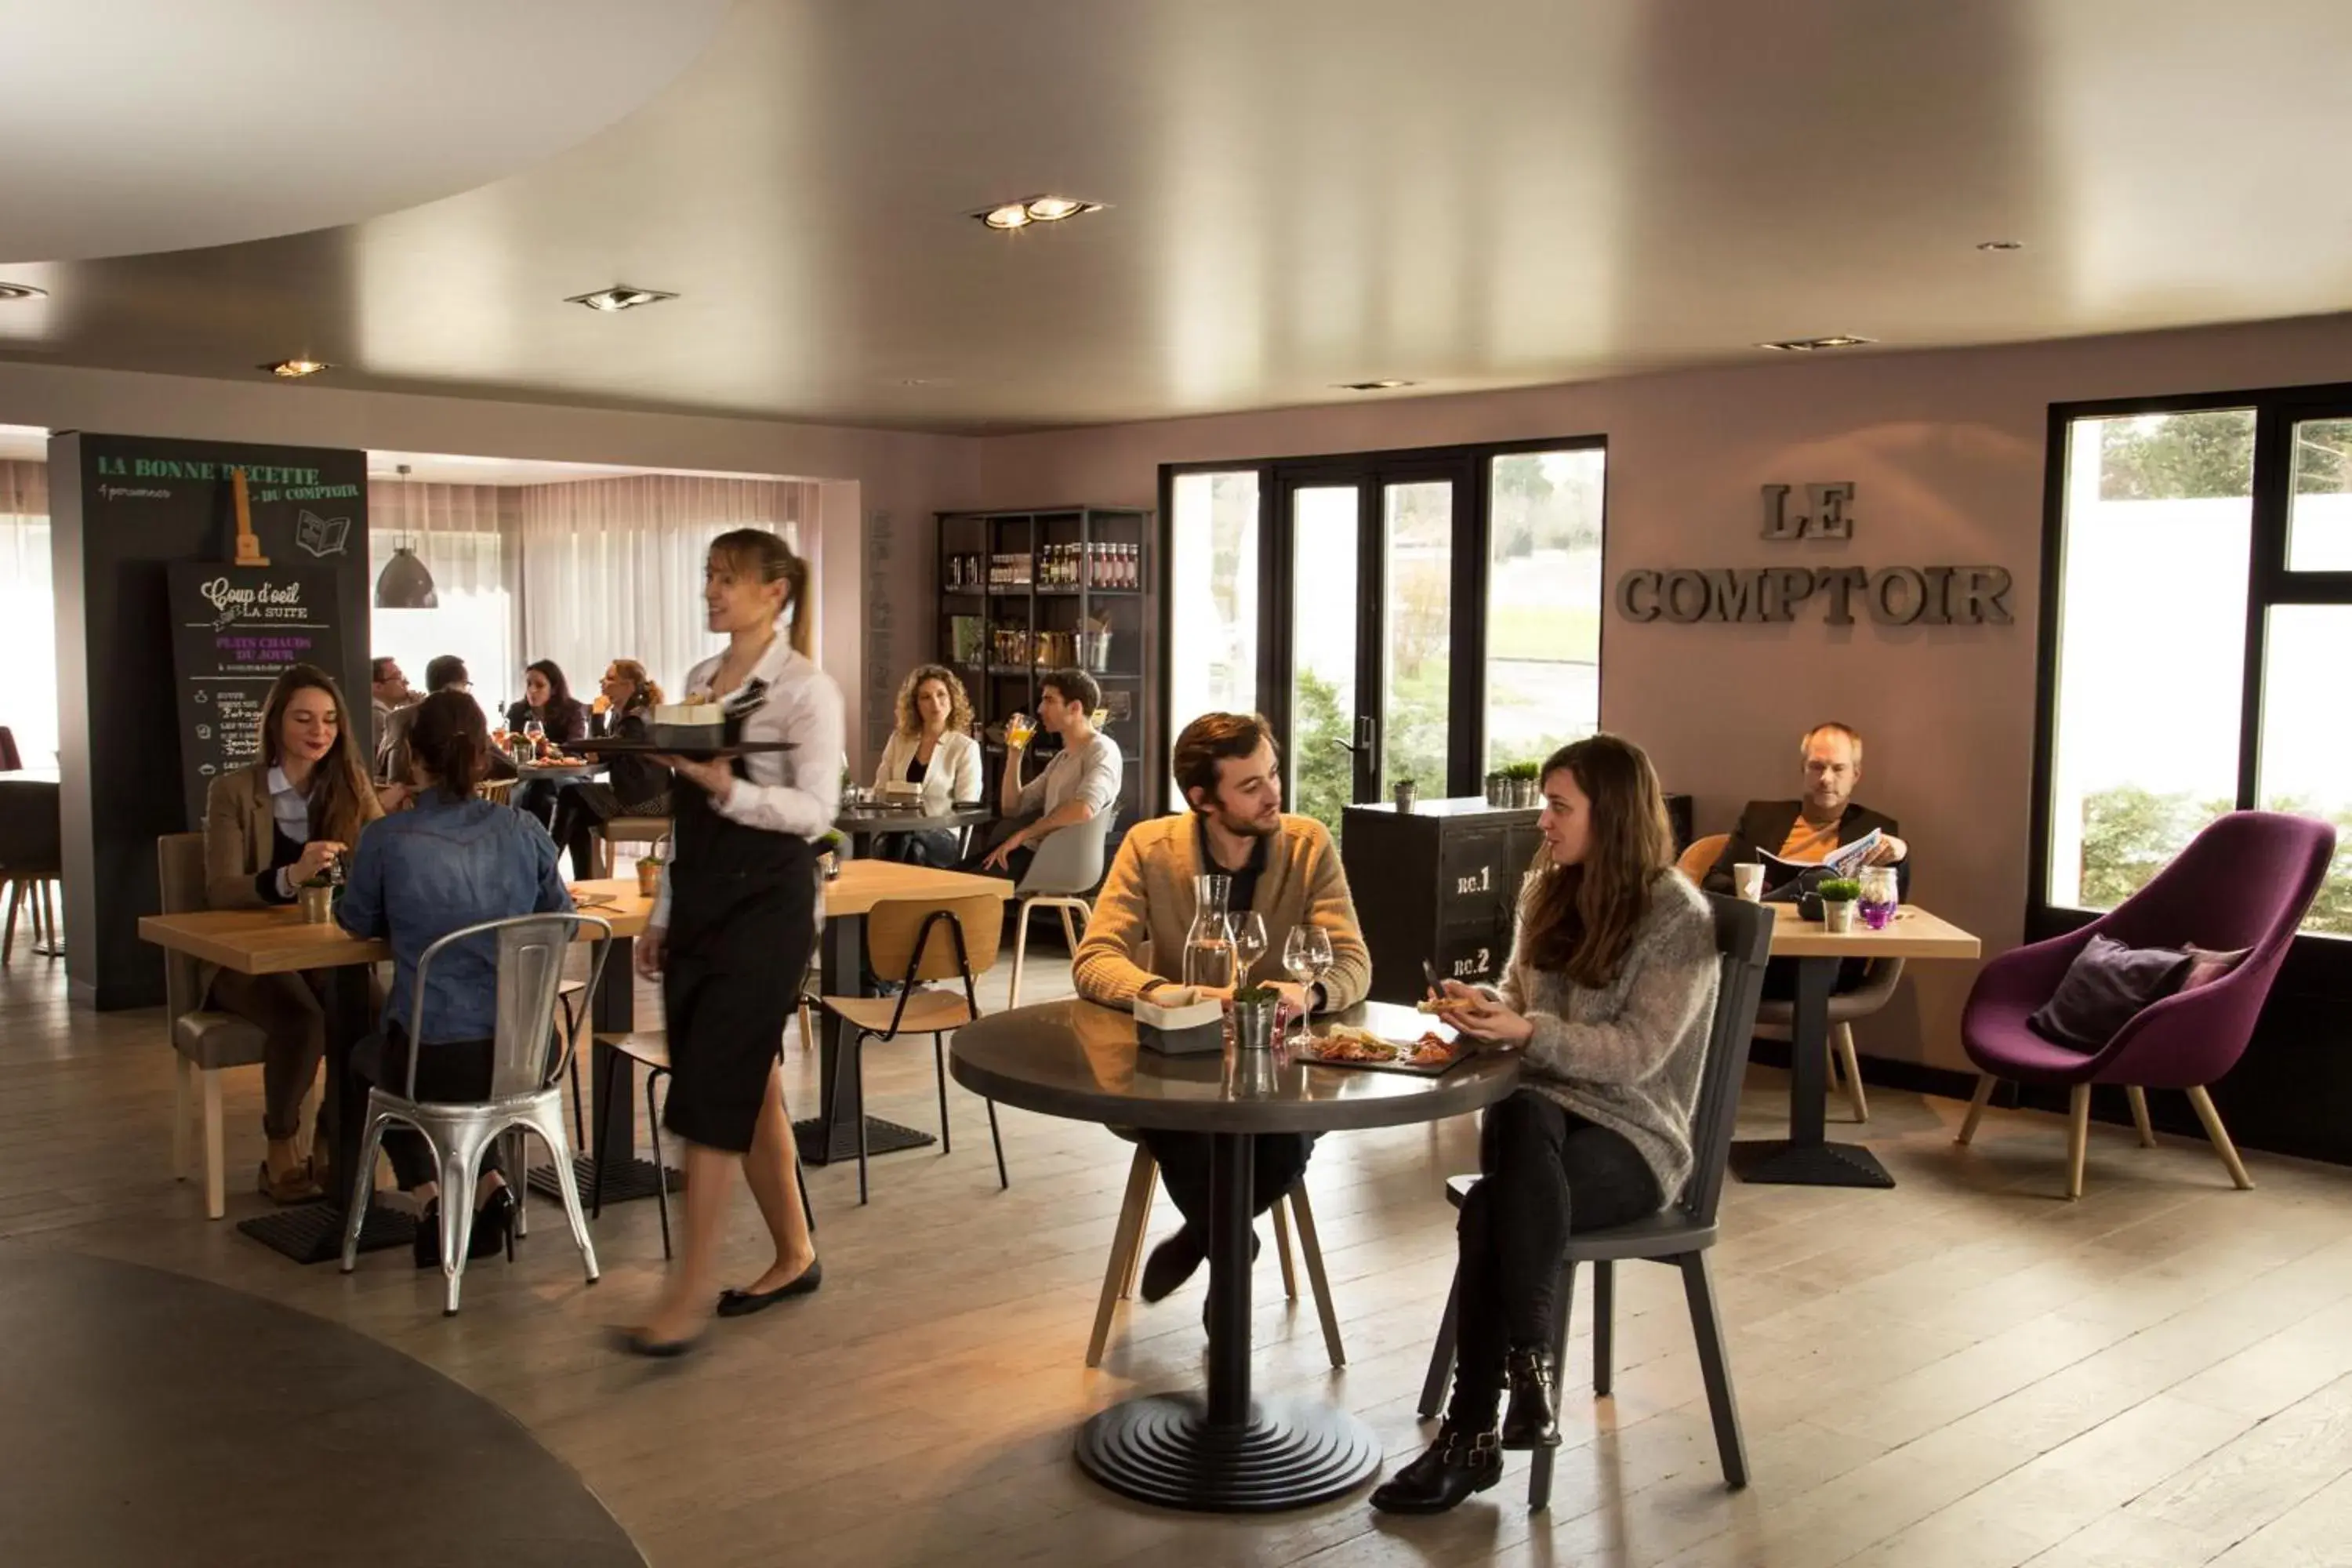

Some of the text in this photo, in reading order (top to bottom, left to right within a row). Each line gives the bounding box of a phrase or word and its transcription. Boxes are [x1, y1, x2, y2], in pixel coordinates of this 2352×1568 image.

[98, 456, 128, 476] LA
[135, 458, 215, 480] BONNE
[285, 484, 360, 501] COMPTOIR
[1759, 481, 1856, 541] LE
[200, 577, 256, 612] Coup
[1615, 564, 2015, 626] COMPTOIR
[244, 603, 308, 619] LA SUITE
[257, 649, 295, 661] JOUR
[260, 637, 312, 649] CHAUDS
[1457, 865, 1490, 895] no.1
[1454, 947, 1490, 976] no.2
